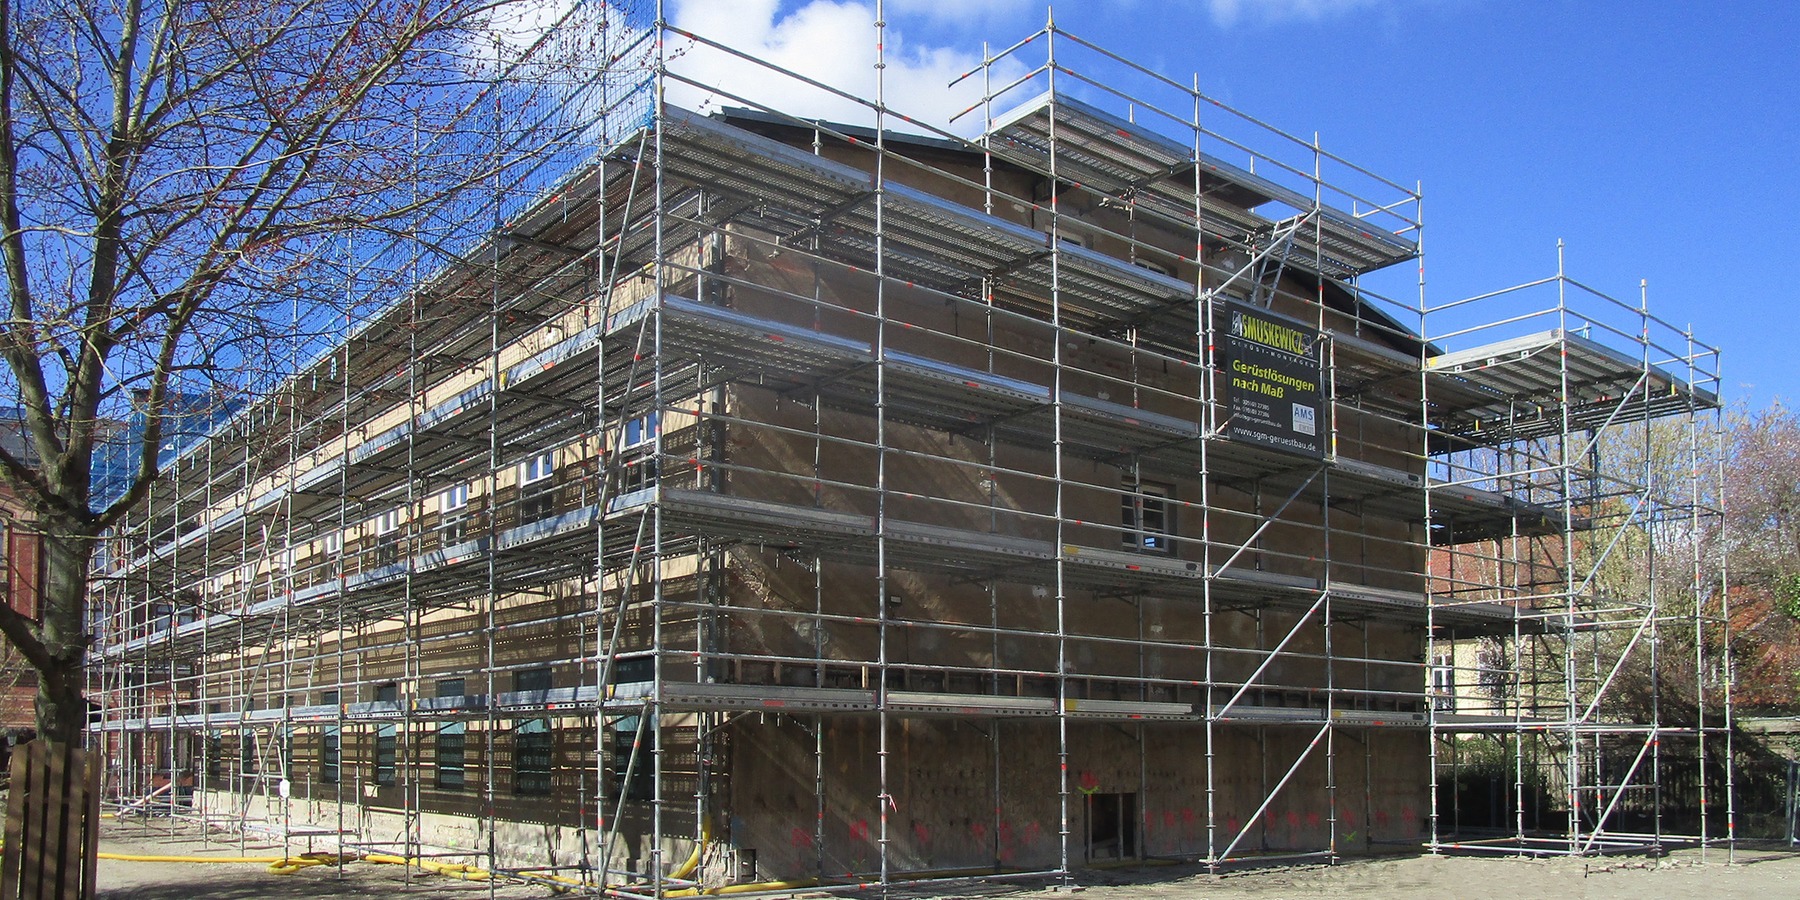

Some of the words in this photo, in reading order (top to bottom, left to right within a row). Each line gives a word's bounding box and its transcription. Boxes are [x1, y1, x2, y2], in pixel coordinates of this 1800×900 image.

[1232, 359, 1315, 392] Gerüstlösungen
[1232, 377, 1259, 392] nach
[1260, 382, 1284, 399] Maß
[1294, 407, 1314, 421] AMS
[1233, 426, 1316, 452] www.sgm-geruestbau.de
